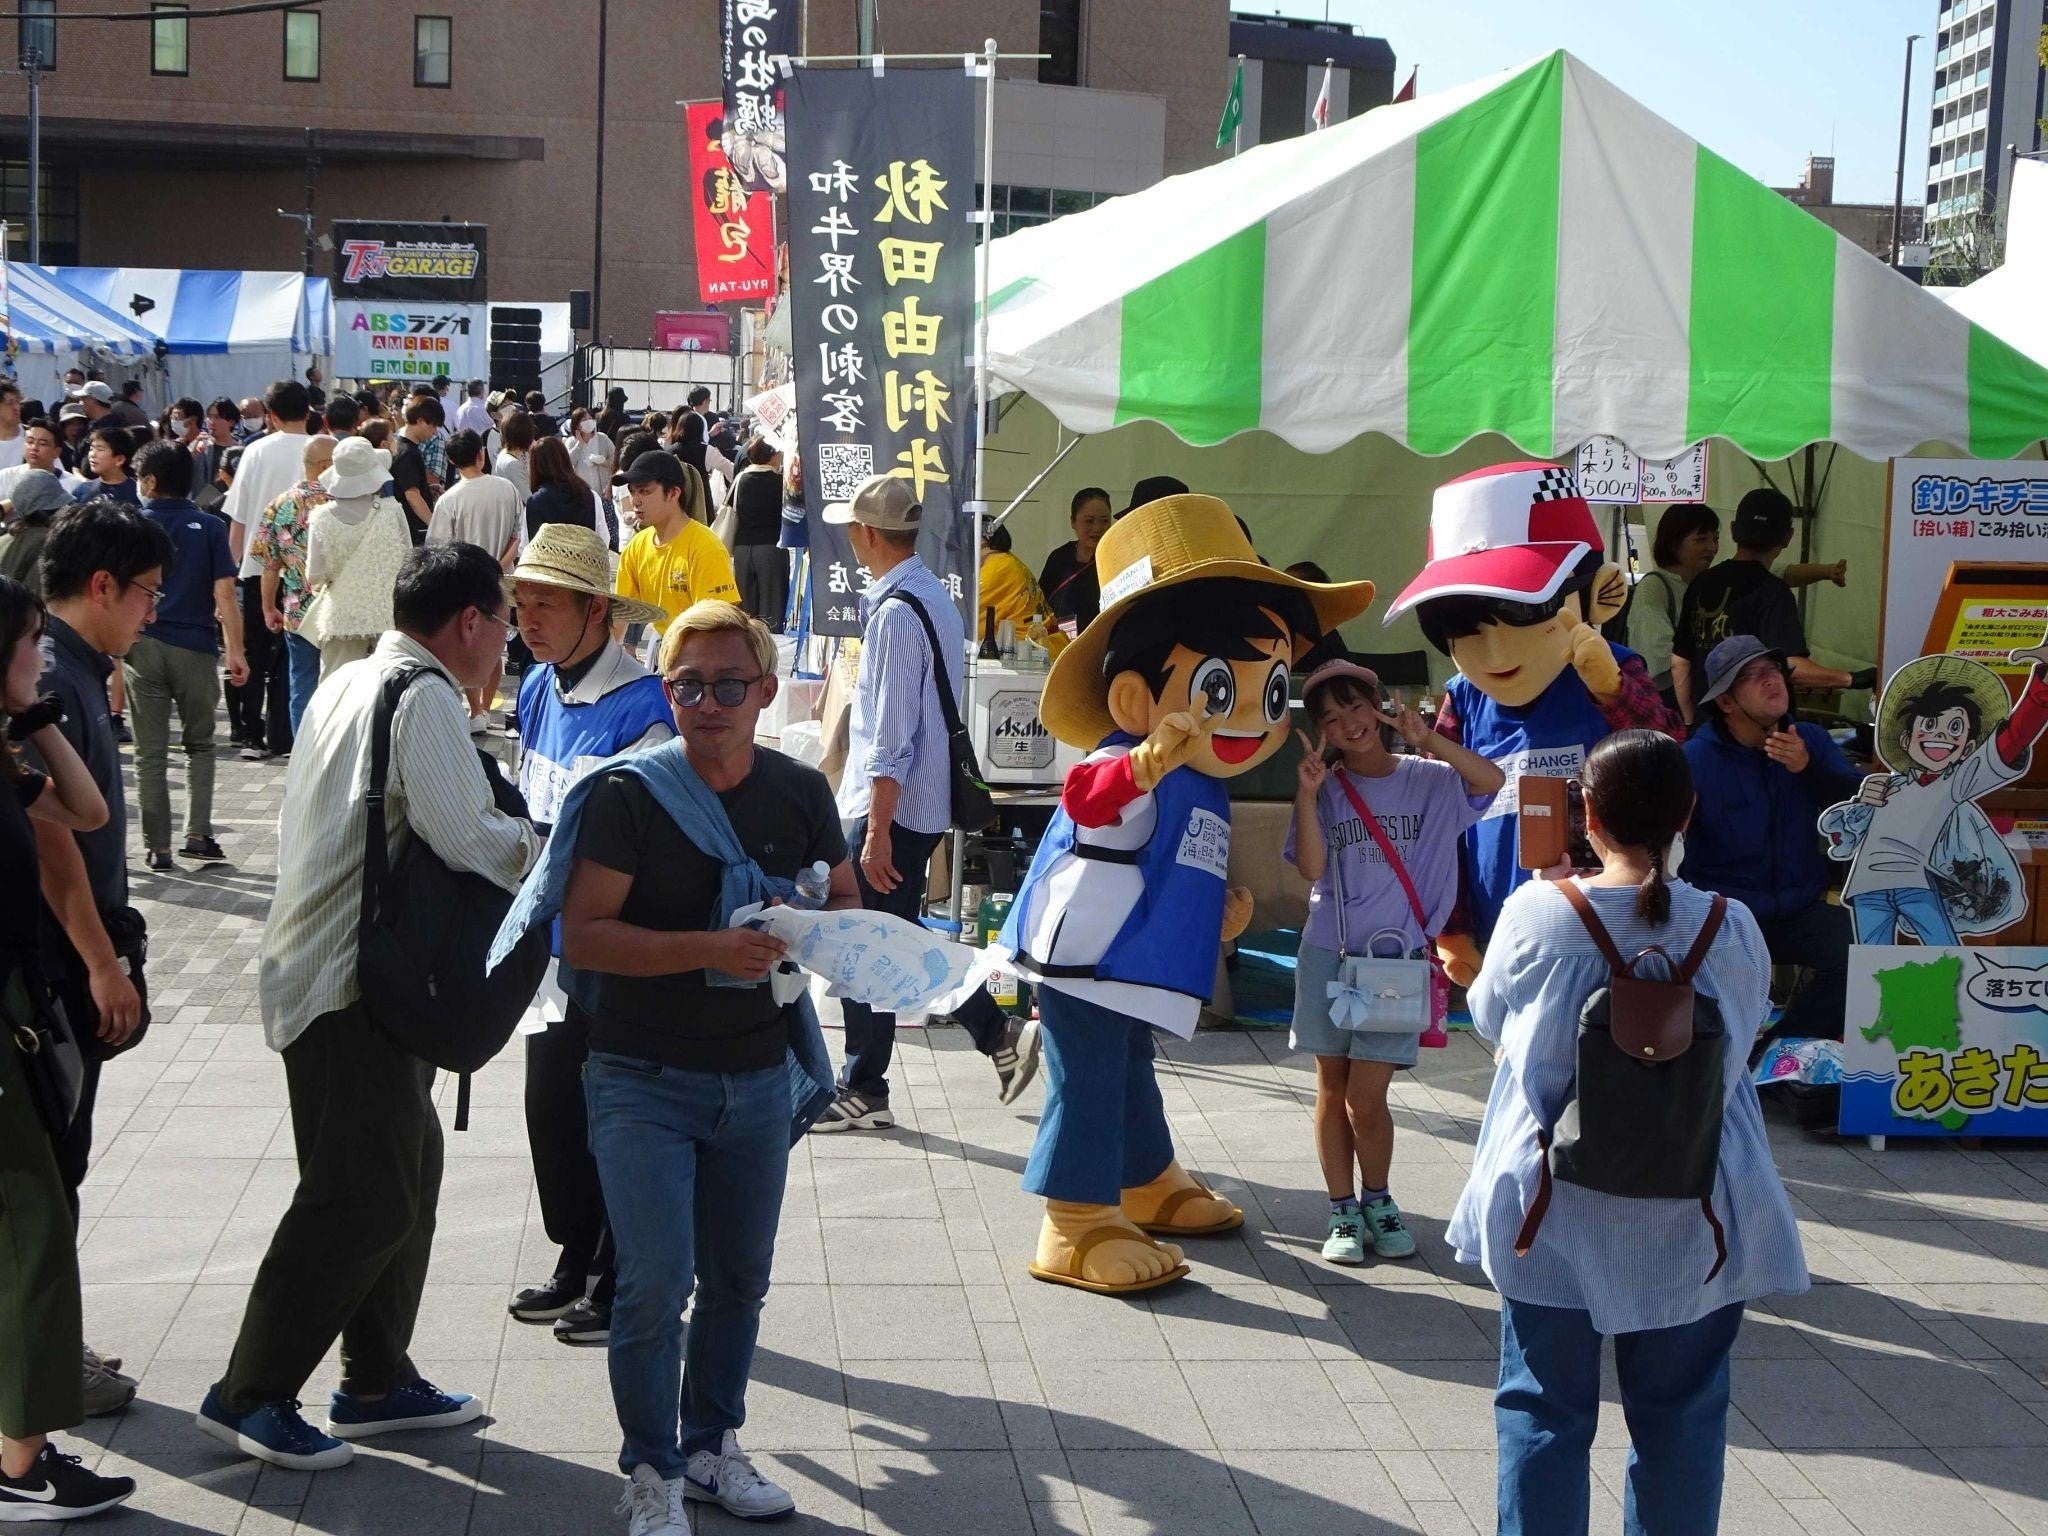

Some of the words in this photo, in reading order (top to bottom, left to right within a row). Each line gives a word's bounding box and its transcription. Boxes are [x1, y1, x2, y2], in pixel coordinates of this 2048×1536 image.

[387, 257, 473, 276] GARAGE
[352, 313, 471, 335] ABSラジオ
[372, 335, 449, 351] AM936
[1583, 478, 1637, 497] 500円
[1014, 741, 1029, 752] 生
[1519, 753, 1579, 771] CHANGE
